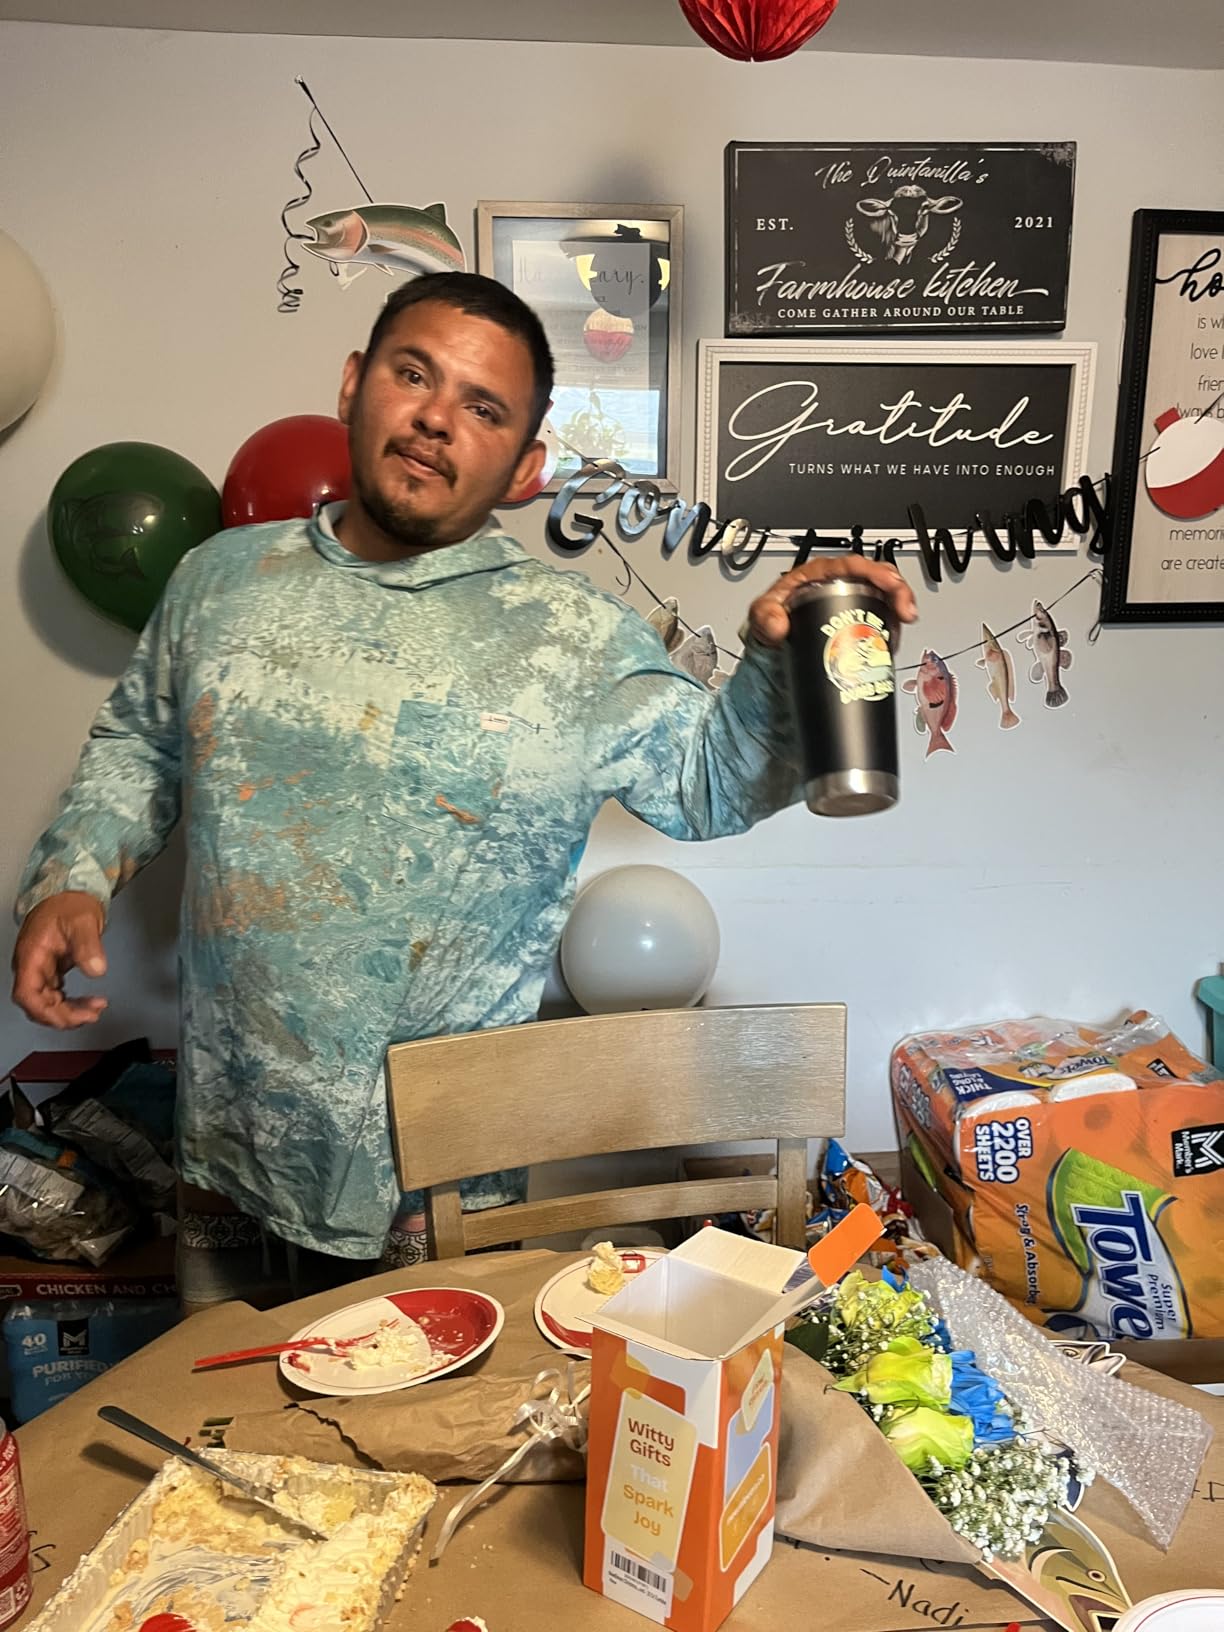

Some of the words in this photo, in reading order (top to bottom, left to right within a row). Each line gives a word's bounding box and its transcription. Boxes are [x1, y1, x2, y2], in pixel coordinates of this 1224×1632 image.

[814, 160, 853, 189] The
[860, 155, 989, 187] Quintanilla's
[756, 217, 794, 231] EST.
[1014, 215, 1053, 229] 2021
[756, 260, 916, 306] Farmhouse
[922, 261, 1049, 305] kitchen
[777, 308, 817, 319] COME
[822, 308, 878, 318] GATHER
[883, 306, 942, 318] AROUND
[947, 306, 976, 316] OUR
[981, 305, 1024, 316] TABLE
[1197, 315, 1207, 329] is
[1190, 342, 1218, 360] love
[725, 380, 1054, 482] Gratitude
[789, 463, 834, 475] TURNS
[840, 463, 880, 475] WHAT
[886, 464, 907, 476] WE
[913, 464, 949, 476] HAVE
[956, 464, 989, 476] INTO
[995, 464, 1055, 477] ENOUGH
[549, 459, 770, 572] Gone
[1161, 559, 1182, 571] are
[955, 1082, 992, 1096] THICK
[992, 1121, 1019, 1182] 2200
[1015, 1117, 1033, 1158] OVER
[976, 1124, 994, 1181] SHEETS
[1181, 1131, 1195, 1174] Member's
[1024, 1237, 1035, 1248] &
[1071, 1190, 1155, 1339] Towe
[36, 1284, 107, 1295] CHICKEN
[113, 1284, 146, 1295] AND
[1161, 1283, 1177, 1322] Super
[21, 1333, 47, 1348] 40
[628, 1418, 674, 1451] Witty
[630, 1439, 671, 1467] Gifts
[631, 1464, 669, 1492] That
[623, 1484, 674, 1518] Spark
[633, 1511, 661, 1536] Joy
